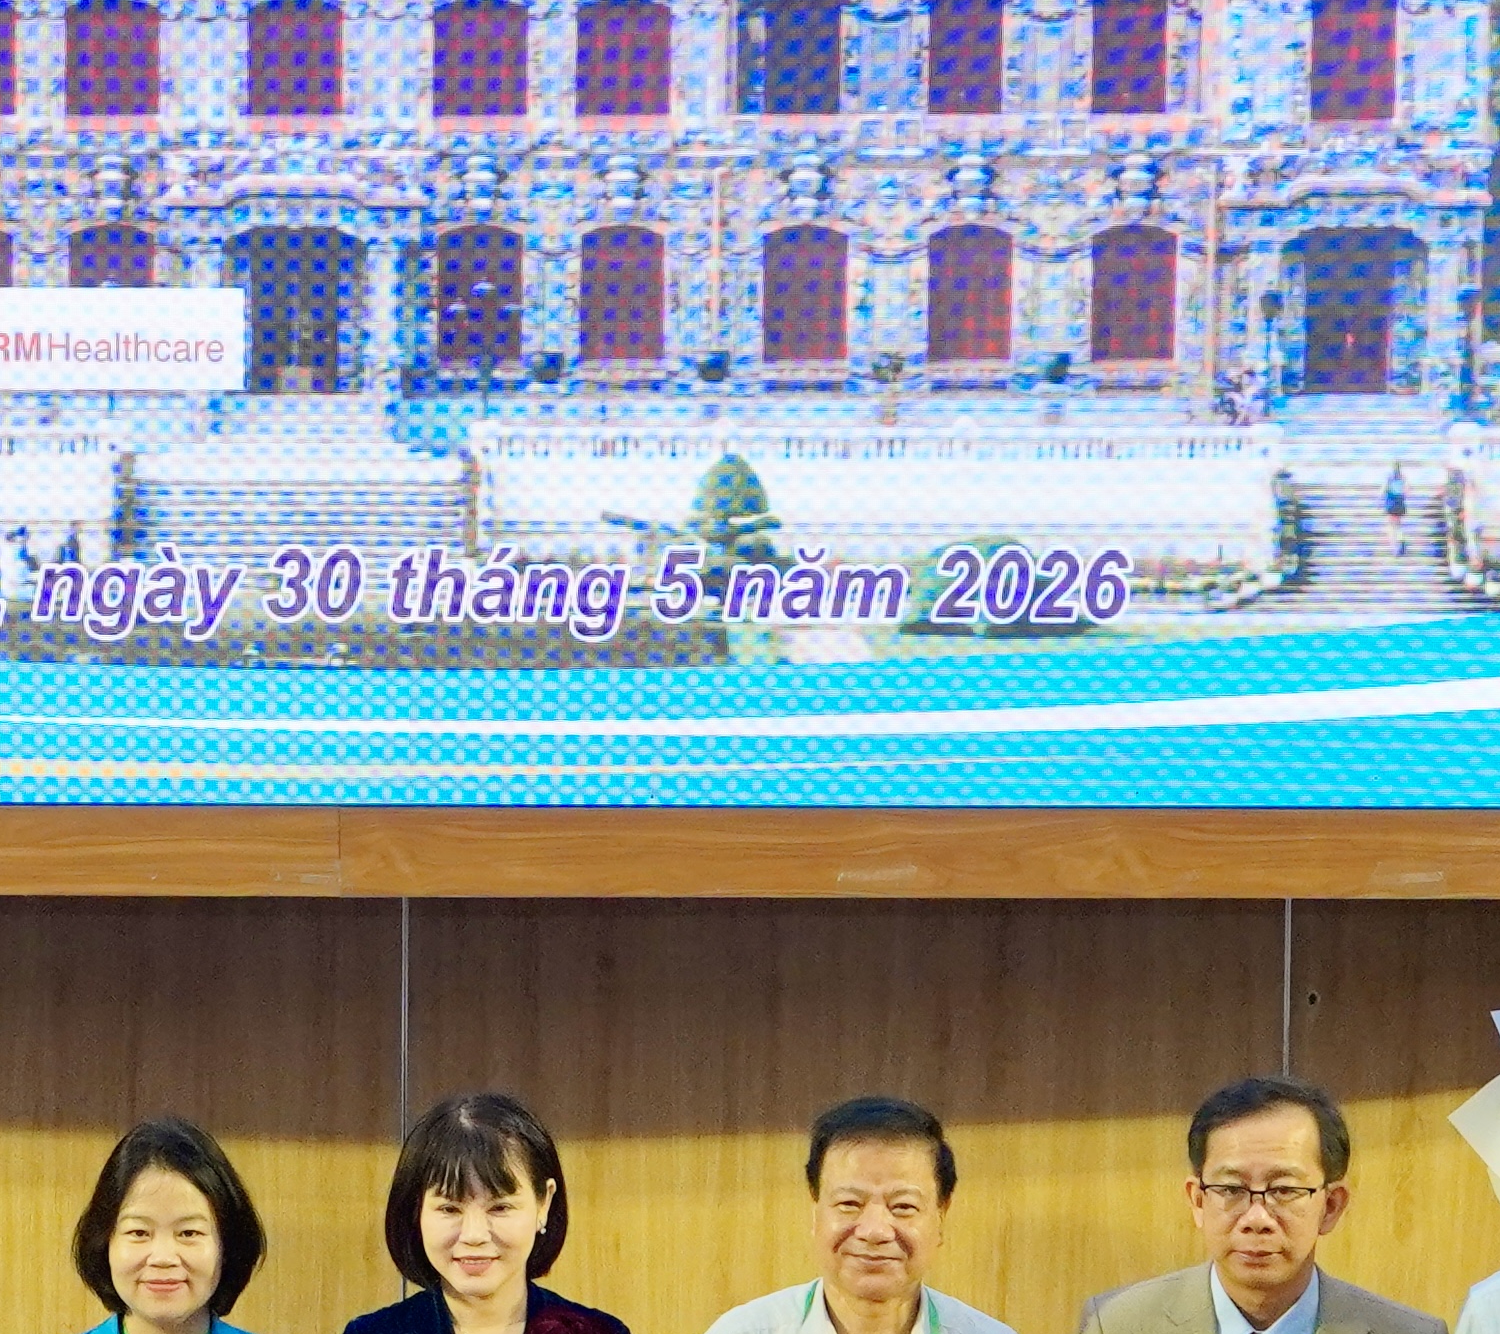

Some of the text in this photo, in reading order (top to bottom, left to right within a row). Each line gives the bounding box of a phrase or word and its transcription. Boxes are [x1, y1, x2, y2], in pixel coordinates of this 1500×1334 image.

[35, 551, 239, 636] ngày
[267, 549, 355, 623] 30
[388, 546, 624, 638] tháng
[655, 549, 705, 619] 5
[725, 549, 904, 621] năm
[932, 547, 1132, 621] 2026
